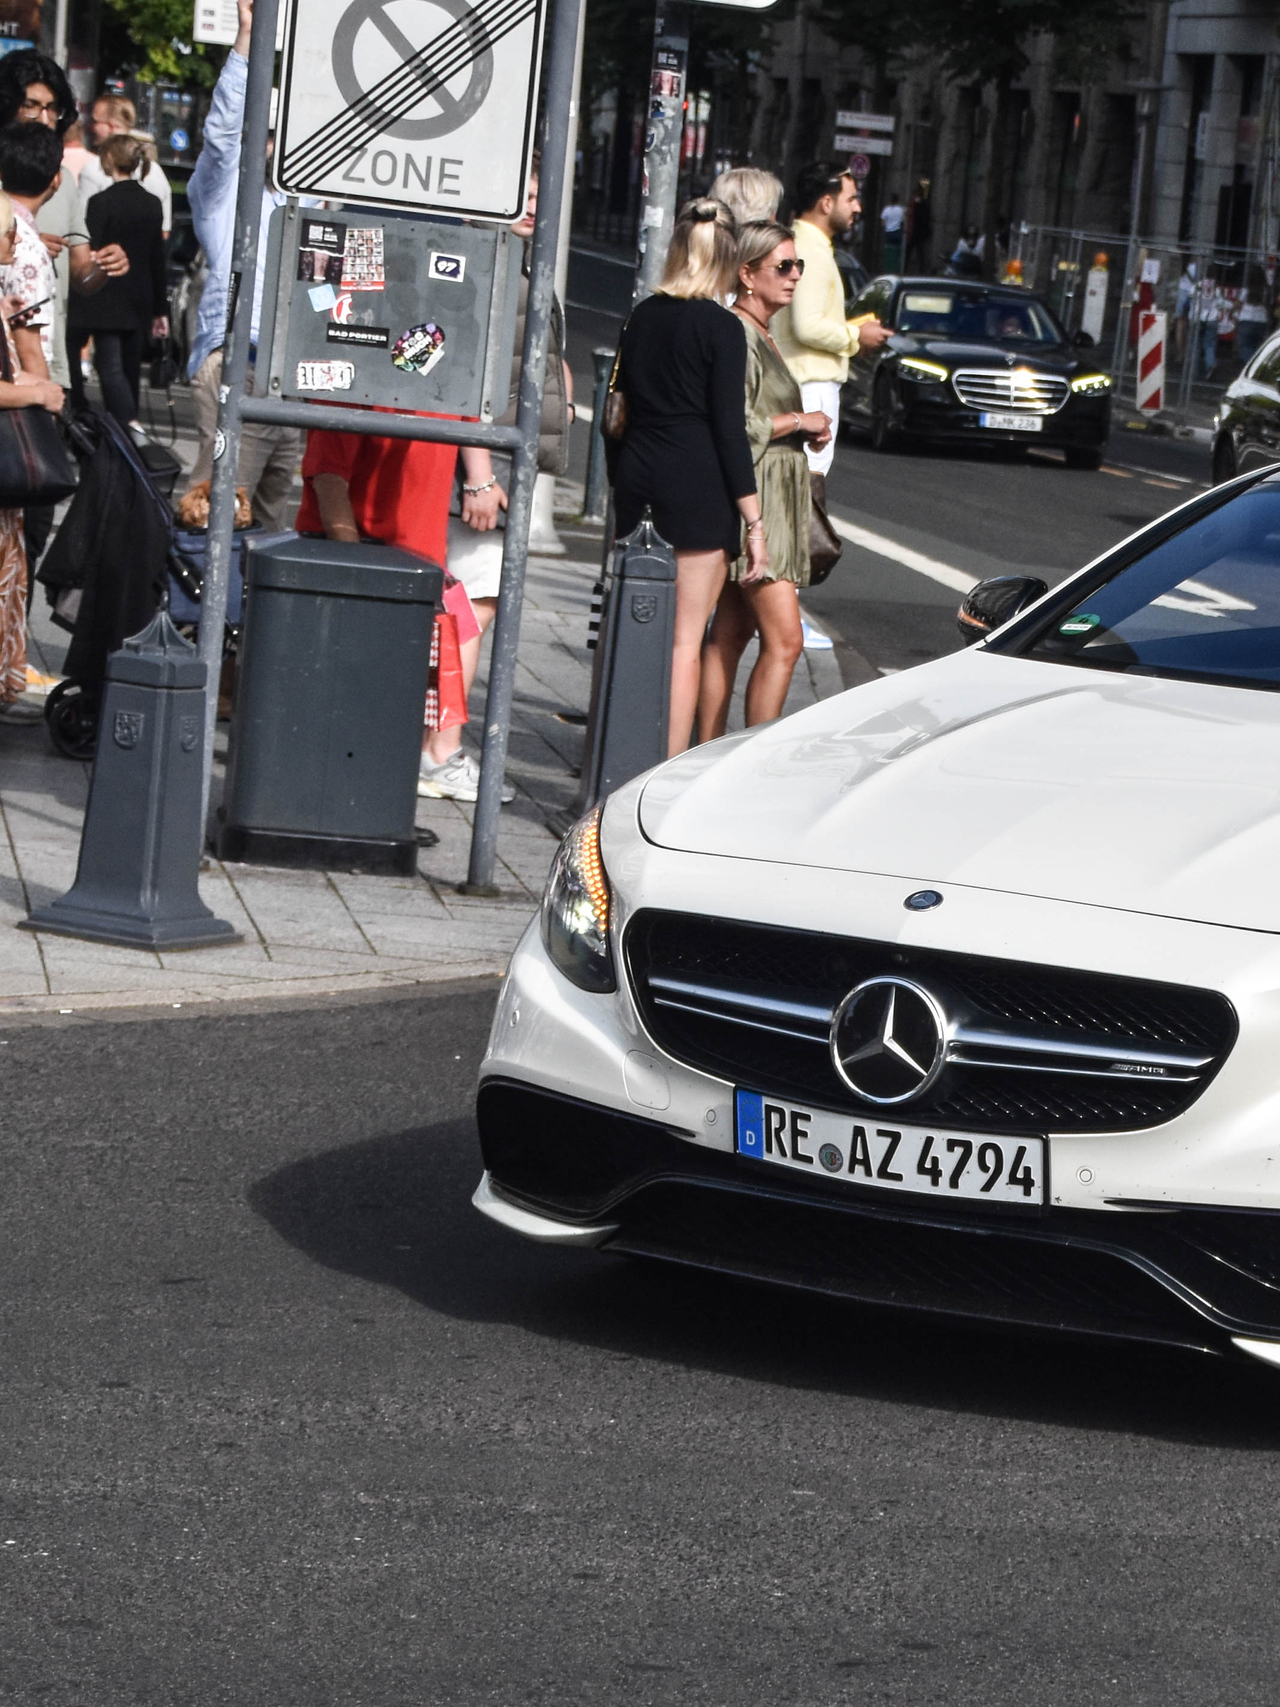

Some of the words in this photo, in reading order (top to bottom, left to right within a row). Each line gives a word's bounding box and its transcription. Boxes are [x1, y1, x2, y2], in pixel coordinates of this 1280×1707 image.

[342, 149, 464, 196] ZONE
[328, 329, 348, 338] BAD
[401, 331, 424, 349] TOO
[745, 1131, 756, 1146] D
[763, 1103, 814, 1165] RE
[847, 1126, 904, 1182] AZ
[916, 1135, 1036, 1198] 4794
